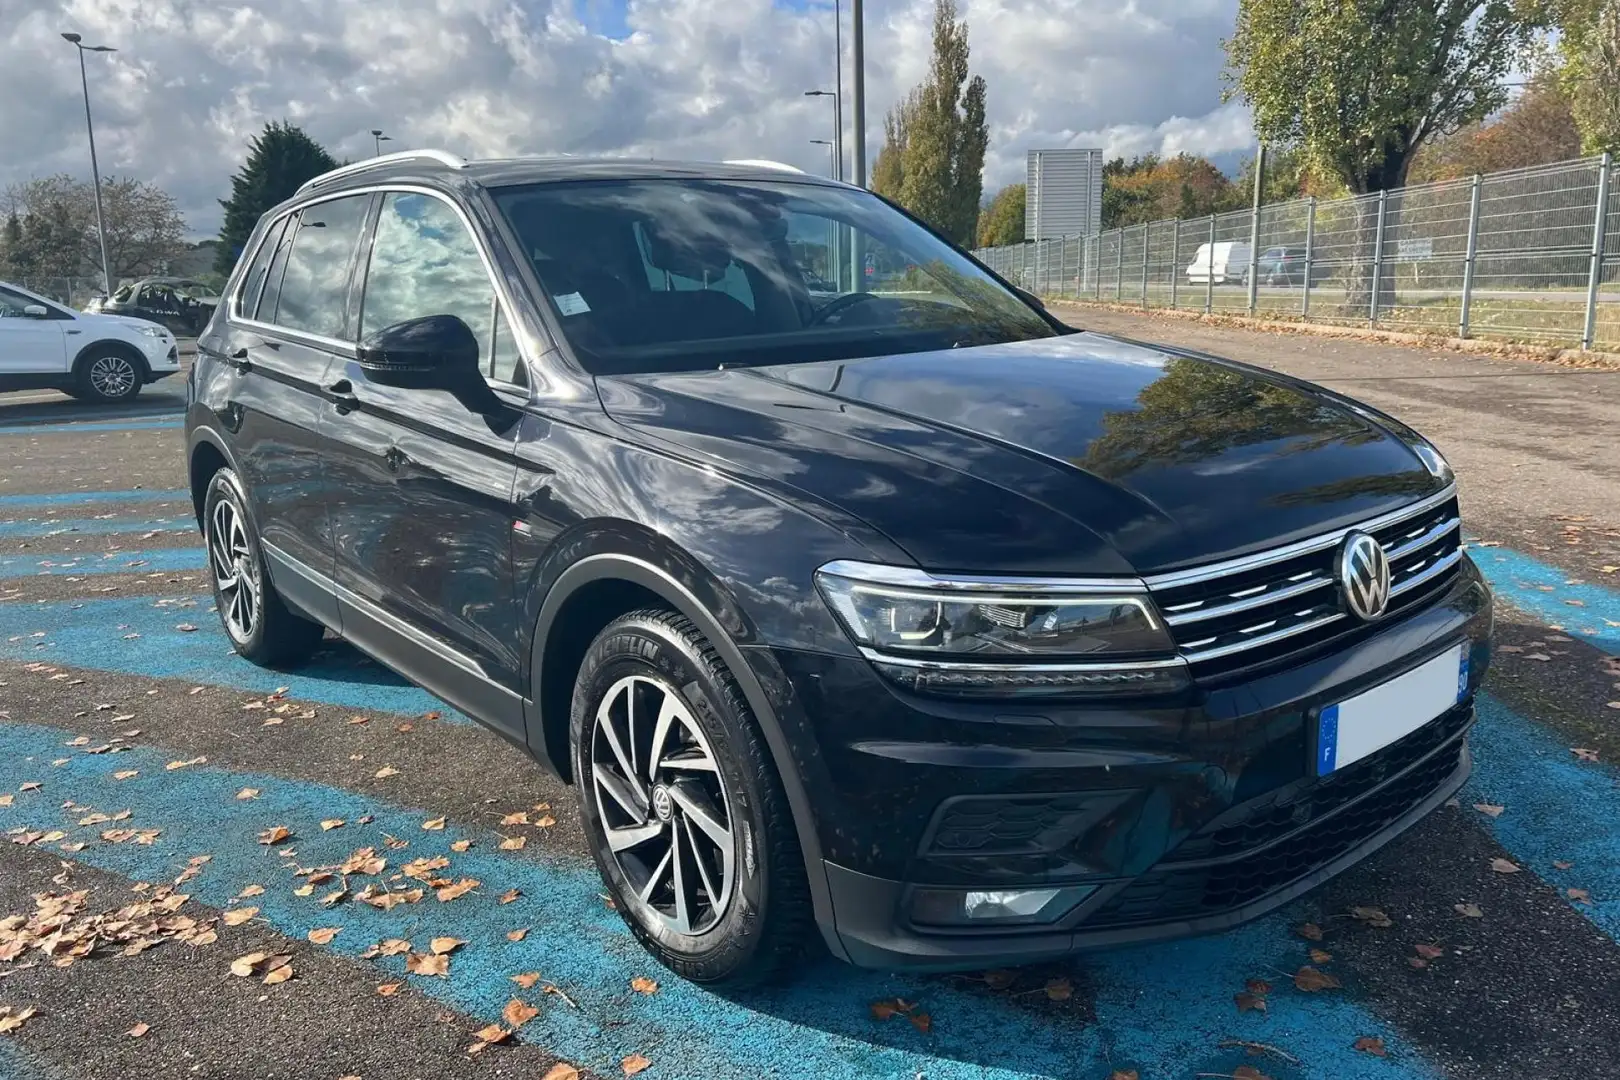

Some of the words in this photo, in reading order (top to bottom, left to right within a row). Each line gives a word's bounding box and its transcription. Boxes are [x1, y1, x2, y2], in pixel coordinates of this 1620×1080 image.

[1343, 534, 1390, 620] VW
[588, 635, 659, 673] MICHELIN
[1324, 747, 1331, 761] F
